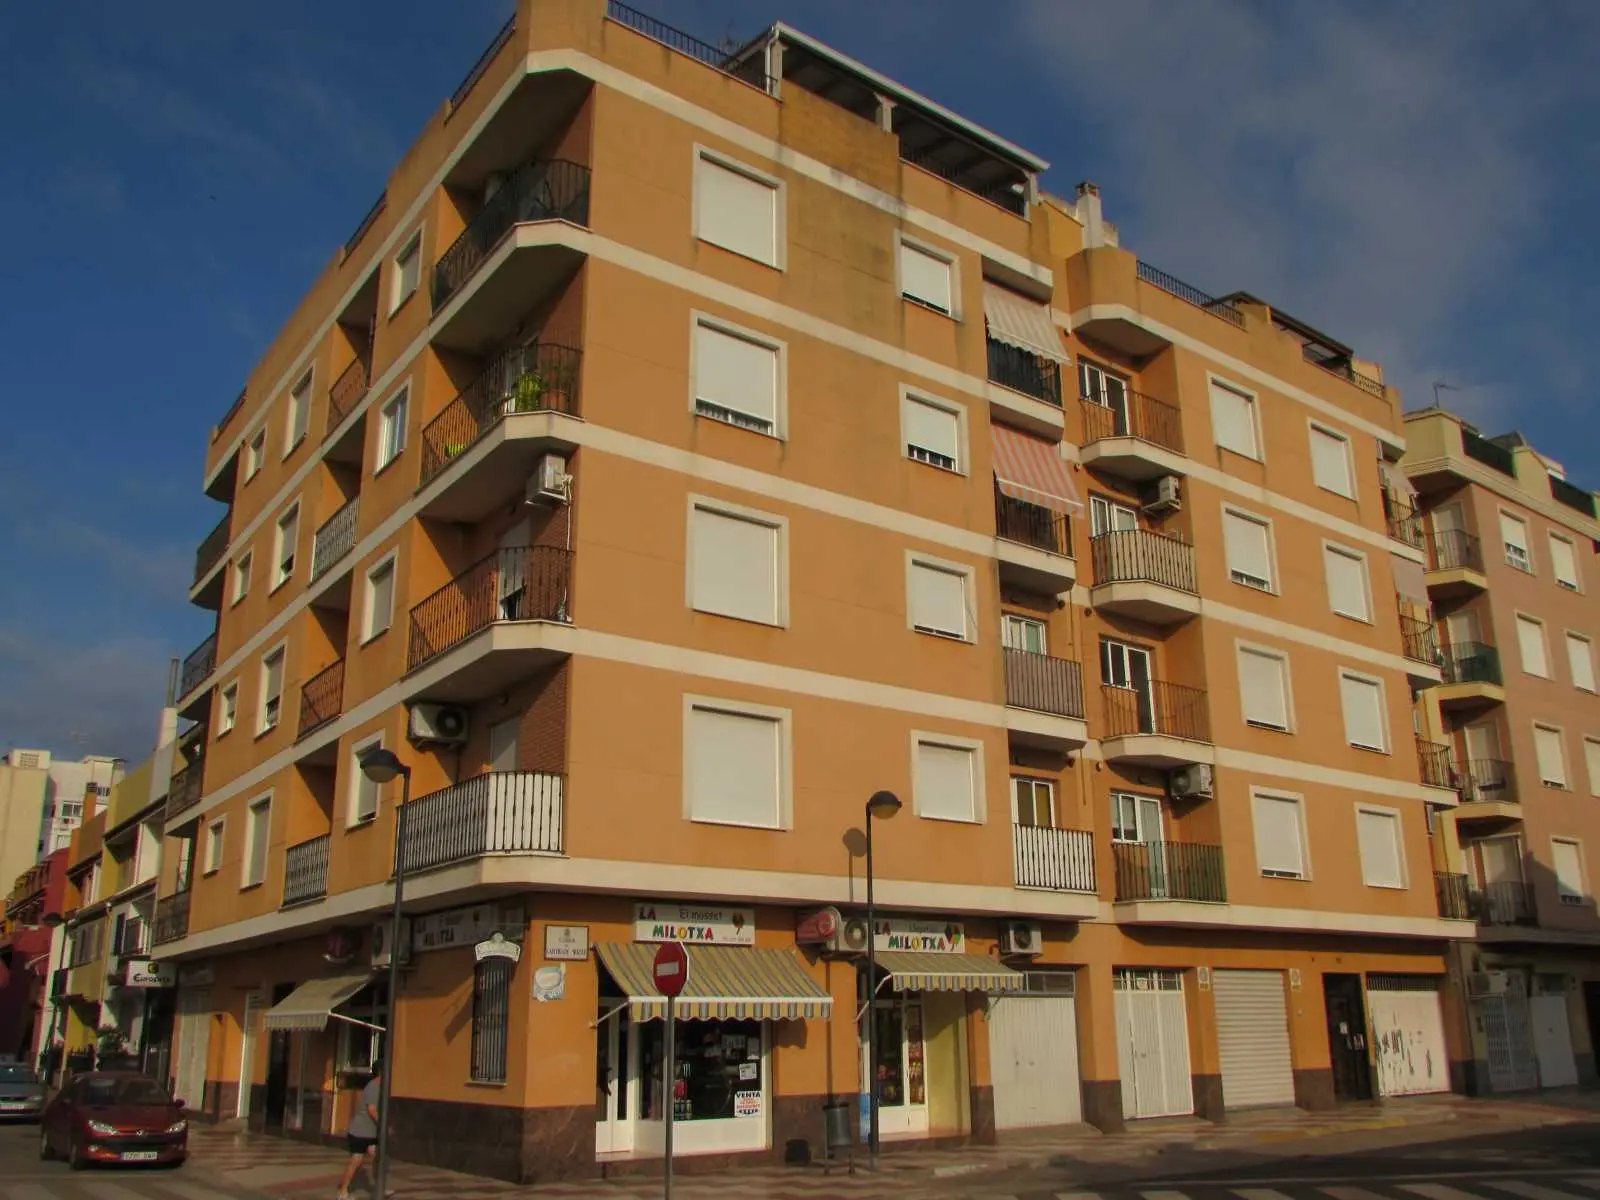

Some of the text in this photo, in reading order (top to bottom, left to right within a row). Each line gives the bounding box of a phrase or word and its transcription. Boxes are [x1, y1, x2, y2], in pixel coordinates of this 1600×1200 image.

[638, 906, 656, 920] LA
[652, 924, 714, 941] MILOTXA
[875, 921, 891, 936] LA
[888, 935, 945, 951] MILOTXA
